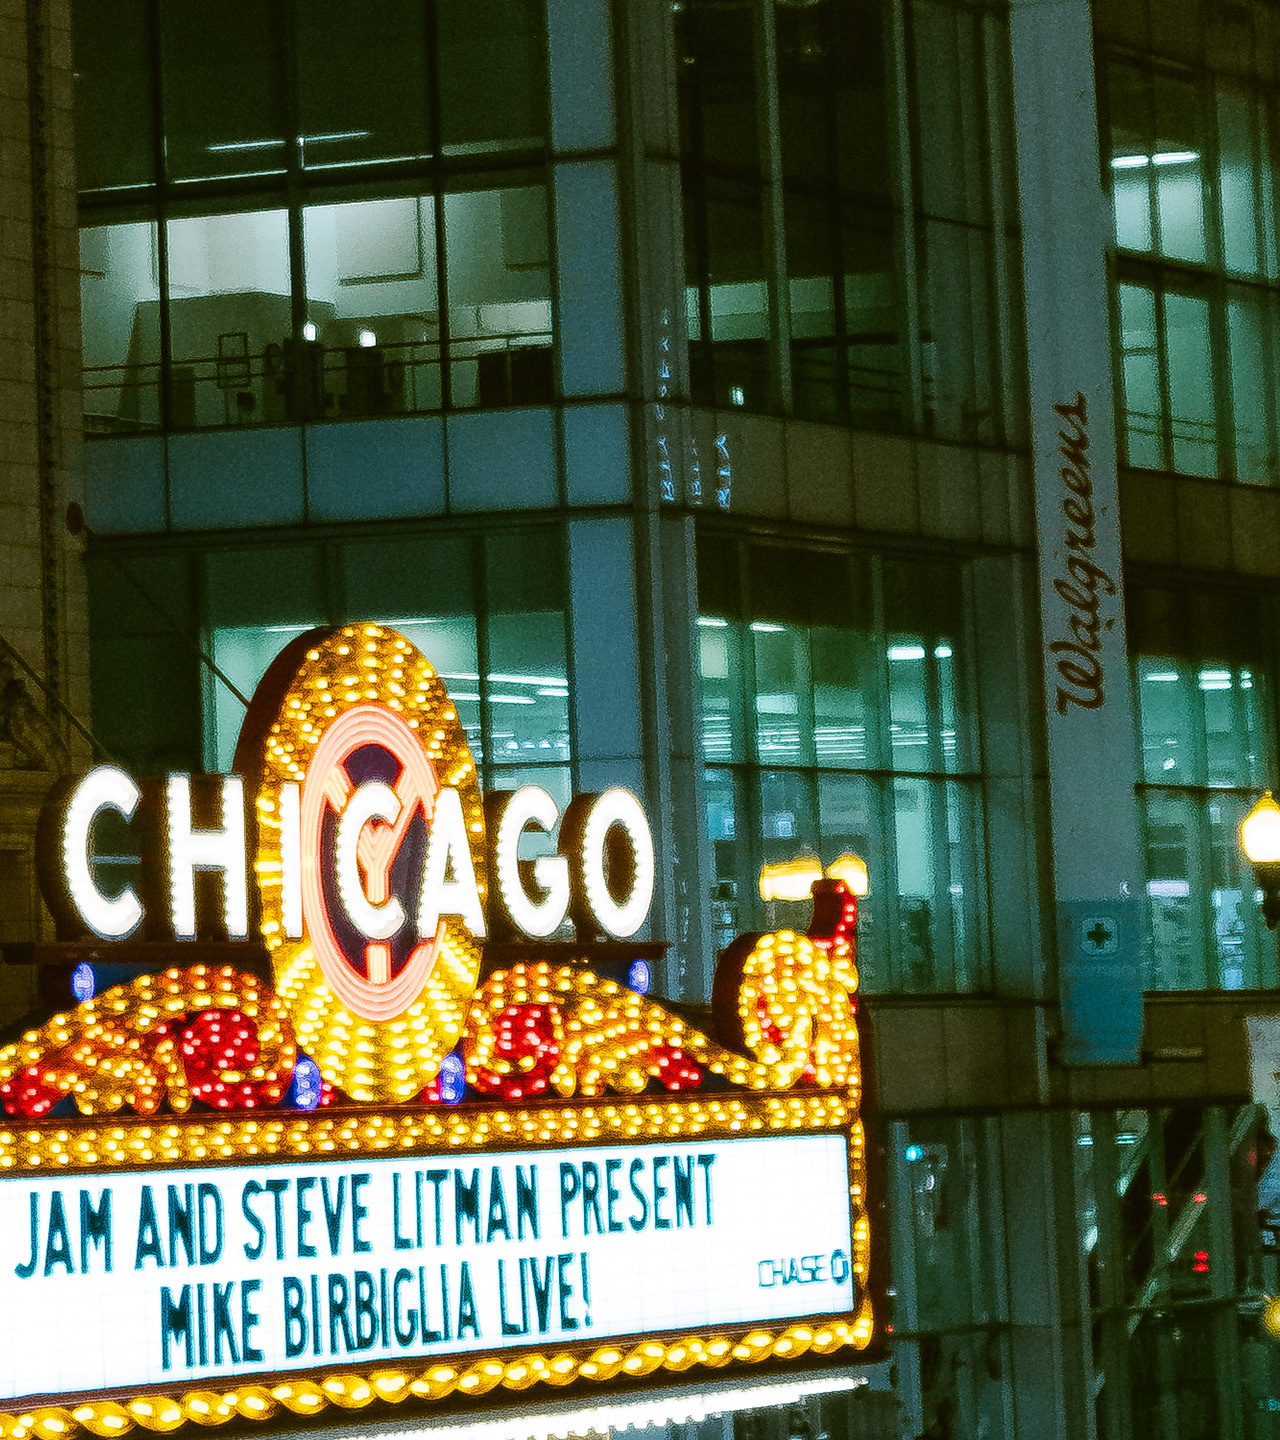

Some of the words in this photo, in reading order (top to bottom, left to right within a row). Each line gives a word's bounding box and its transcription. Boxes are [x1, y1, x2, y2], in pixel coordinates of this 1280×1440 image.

[1049, 391, 1116, 716] Walgreens
[60, 762, 654, 940] CHICAGO
[13, 1187, 114, 1280] JAM
[134, 1182, 225, 1272] AND
[242, 1173, 372, 1262] STEVE
[392, 1164, 539, 1254] LITMAN
[560, 1153, 717, 1239] PRESENT
[758, 1254, 828, 1288] CHASE
[160, 1277, 264, 1372] MIKE
[282, 1260, 480, 1361] BIRBIGLIA
[497, 1251, 593, 1336] LIVE!
